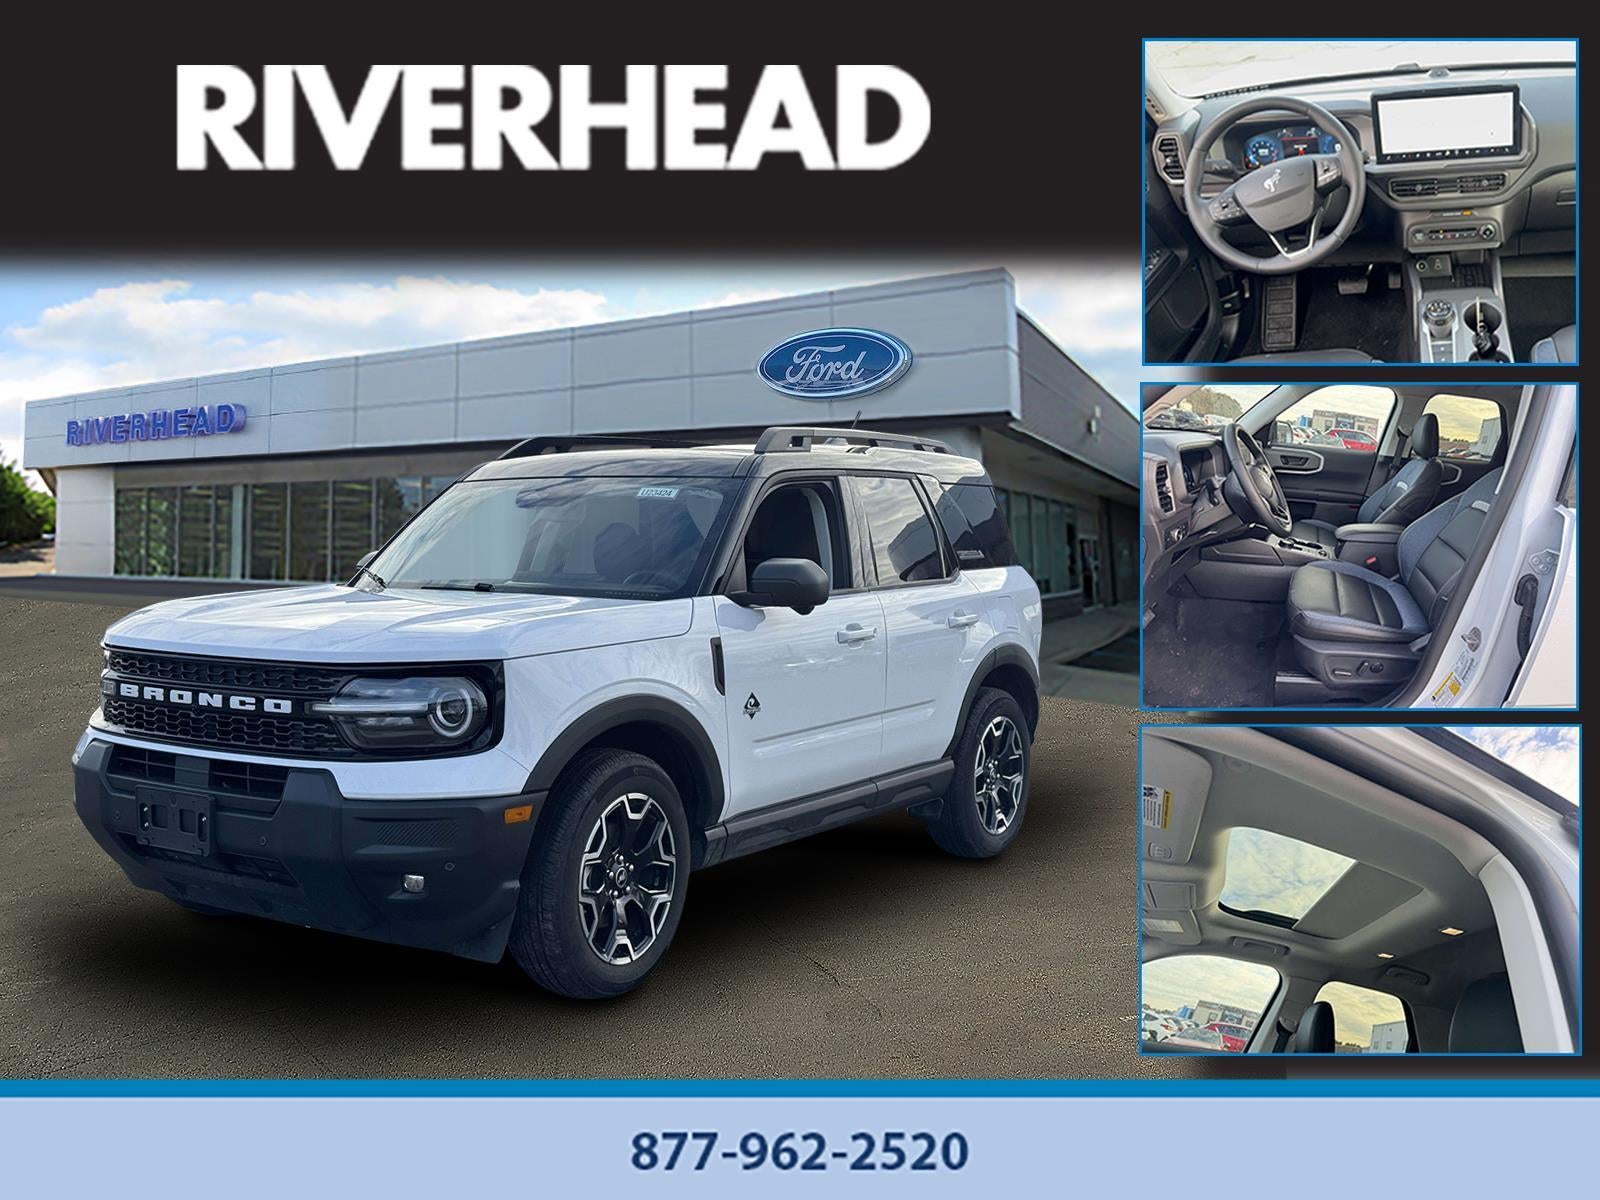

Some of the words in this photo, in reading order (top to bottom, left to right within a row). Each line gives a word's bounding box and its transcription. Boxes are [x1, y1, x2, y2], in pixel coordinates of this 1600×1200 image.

[785, 344, 867, 384] Ford
[66, 403, 239, 447] RIVERHEAD
[120, 682, 293, 714] BRONCO
